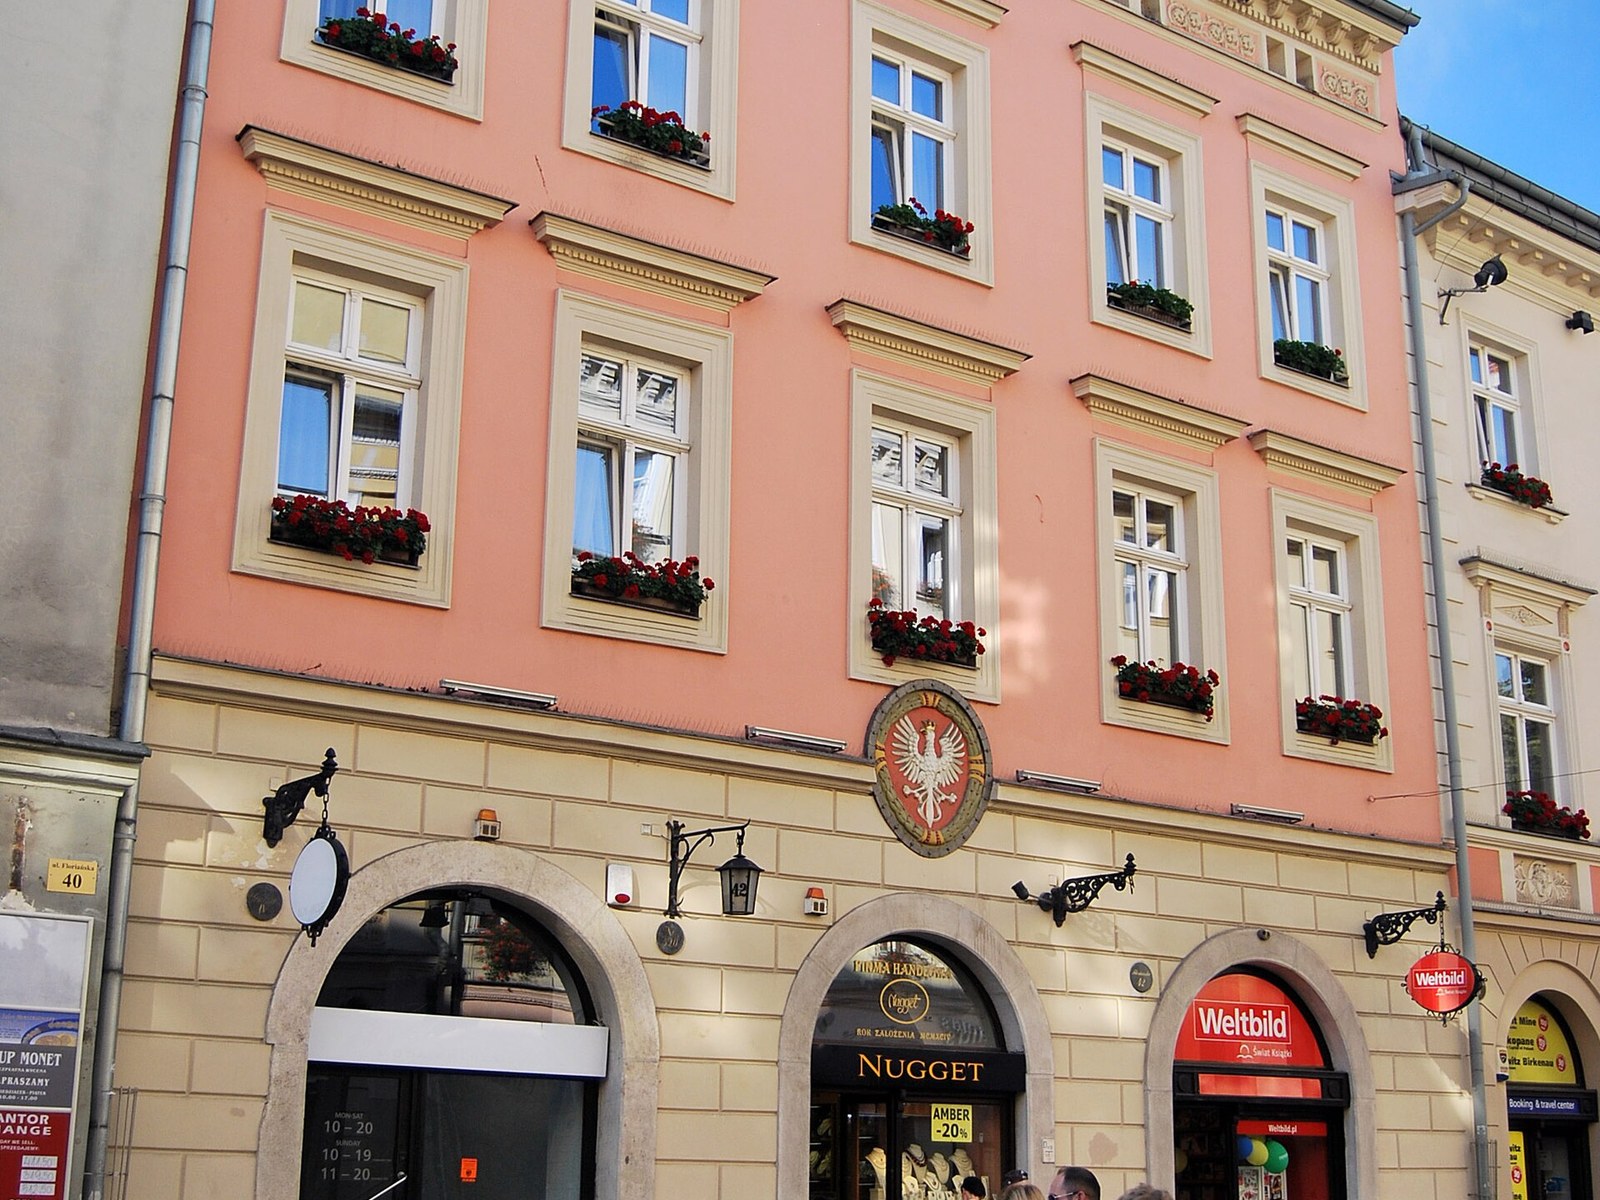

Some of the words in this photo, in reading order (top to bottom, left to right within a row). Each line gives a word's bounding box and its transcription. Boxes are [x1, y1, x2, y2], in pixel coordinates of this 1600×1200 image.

[62, 873, 82, 889] 40
[732, 883, 747, 897] 42
[1414, 970, 1466, 987] Weltbild
[888, 993, 921, 1014] Nugget
[1198, 1007, 1287, 1038] Weltbild
[20, 1052, 62, 1066] MONET
[1523, 1057, 1554, 1067] Birkenau
[1509, 1098, 1533, 1110] Booking
[1535, 1099, 1540, 1108] &
[1541, 1100, 1556, 1109] travel
[1557, 1101, 1575, 1109] center
[933, 1107, 970, 1121] AMBER
[324, 1120, 341, 1133] 10
[356, 1121, 373, 1134] 20
[936, 1123, 968, 1139] -20%
[1268, 1124, 1298, 1134] Weltbild.pl
[322, 1148, 339, 1161] 10
[355, 1149, 371, 1162] 19
[321, 1167, 336, 1180] 11
[353, 1167, 370, 1180] 20
